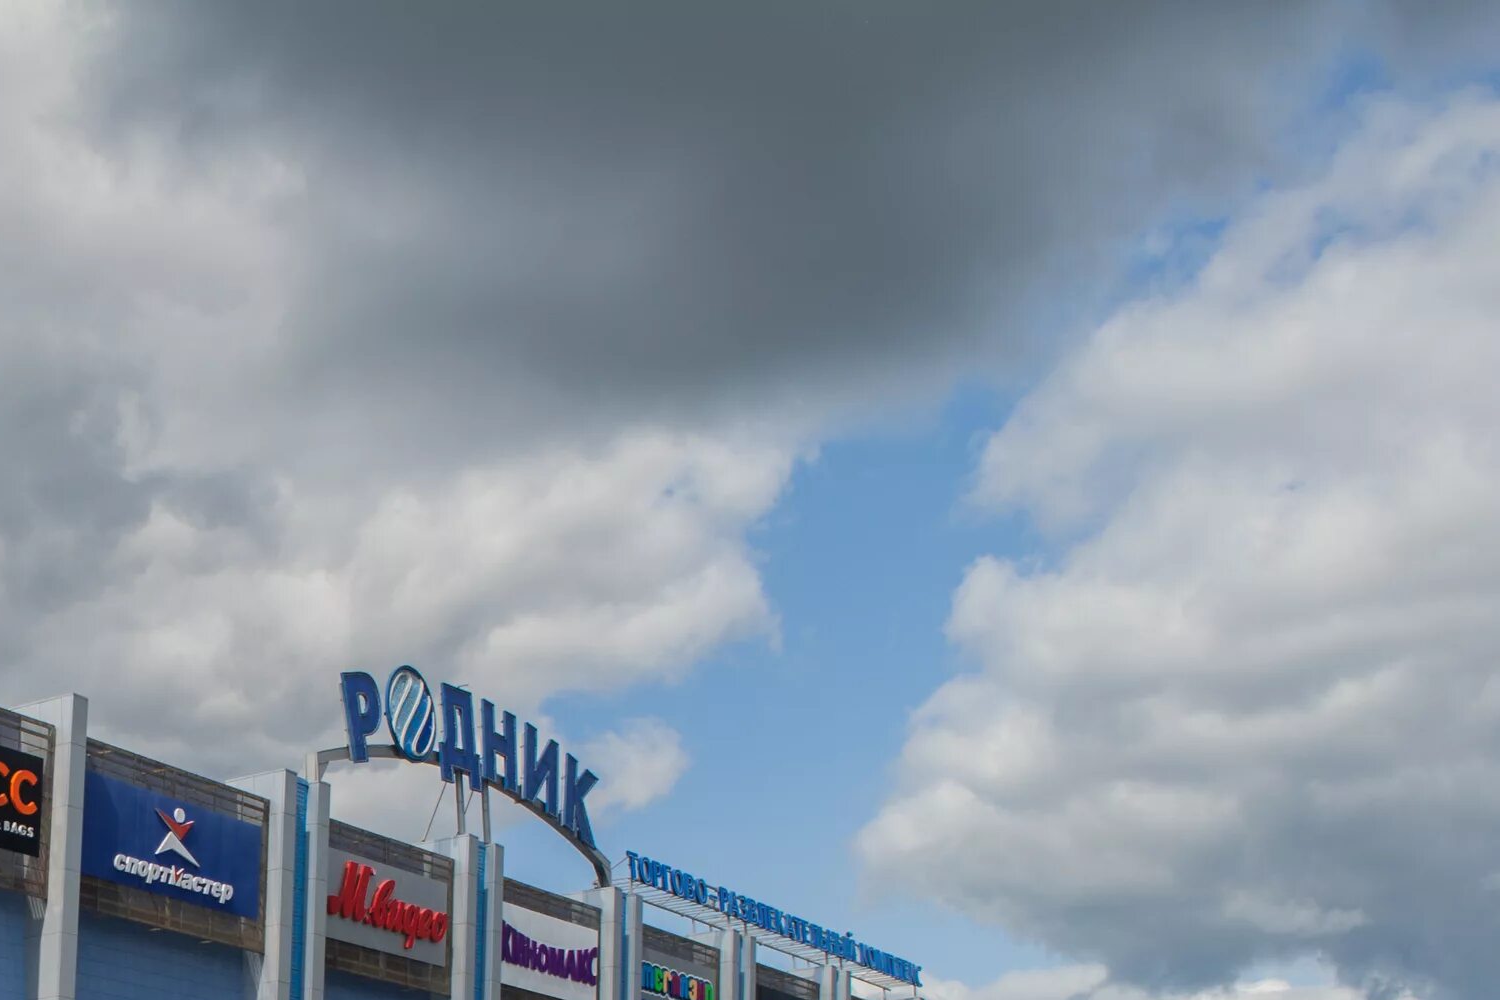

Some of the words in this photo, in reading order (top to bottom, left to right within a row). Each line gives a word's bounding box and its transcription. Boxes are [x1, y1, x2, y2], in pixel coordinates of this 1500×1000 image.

[340, 665, 599, 850] РОДНИК
[3, 820, 34, 838] BAGS
[502, 919, 598, 986] КИНОМАКС
